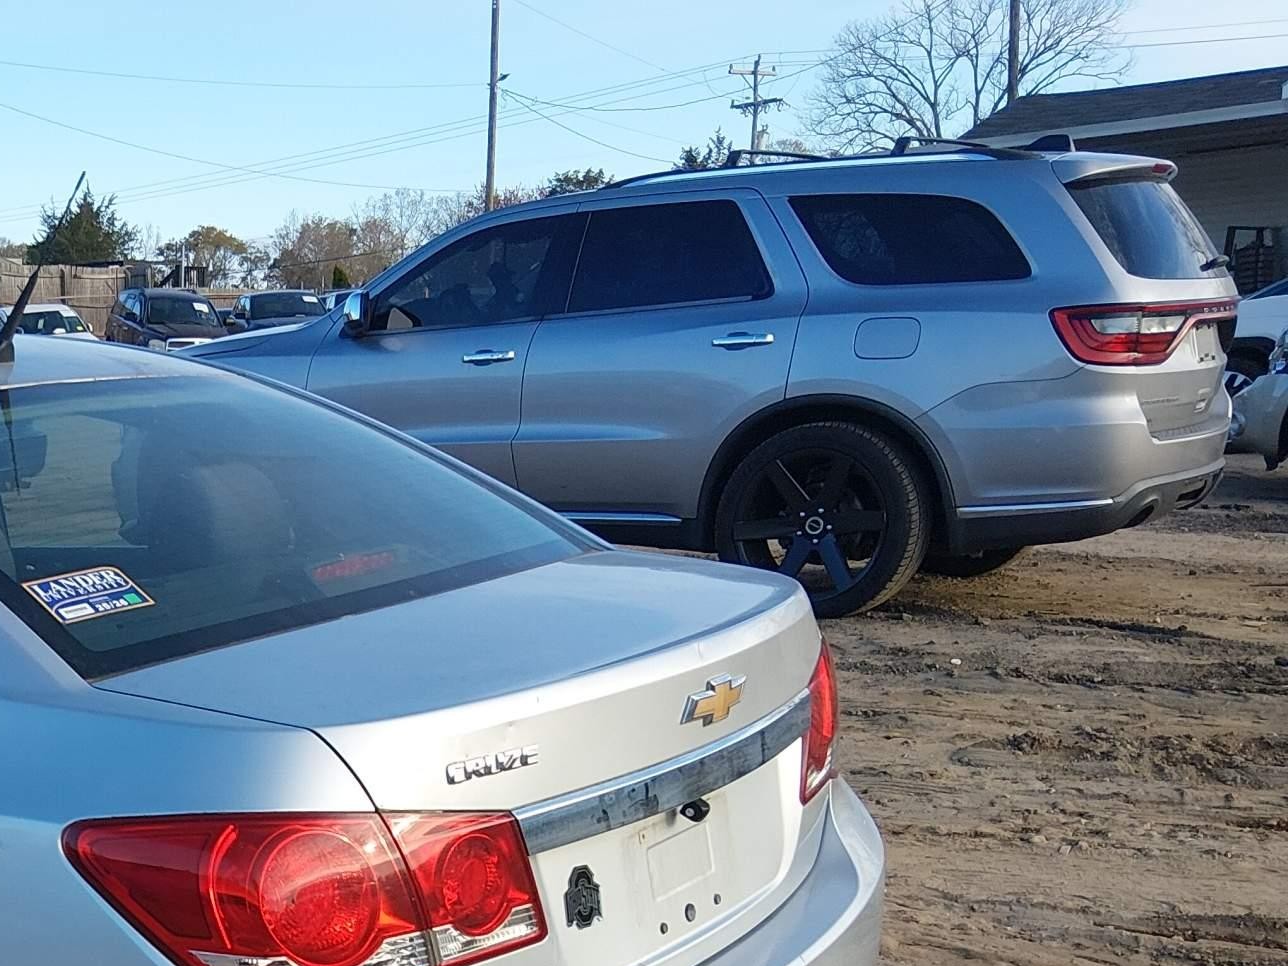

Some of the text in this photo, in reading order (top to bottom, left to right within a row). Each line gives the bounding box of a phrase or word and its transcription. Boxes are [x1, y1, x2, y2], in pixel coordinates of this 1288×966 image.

[30, 569, 120, 596] LANDER
[42, 578, 127, 602] UNIVERSITY
[446, 744, 539, 785] CRUZE
